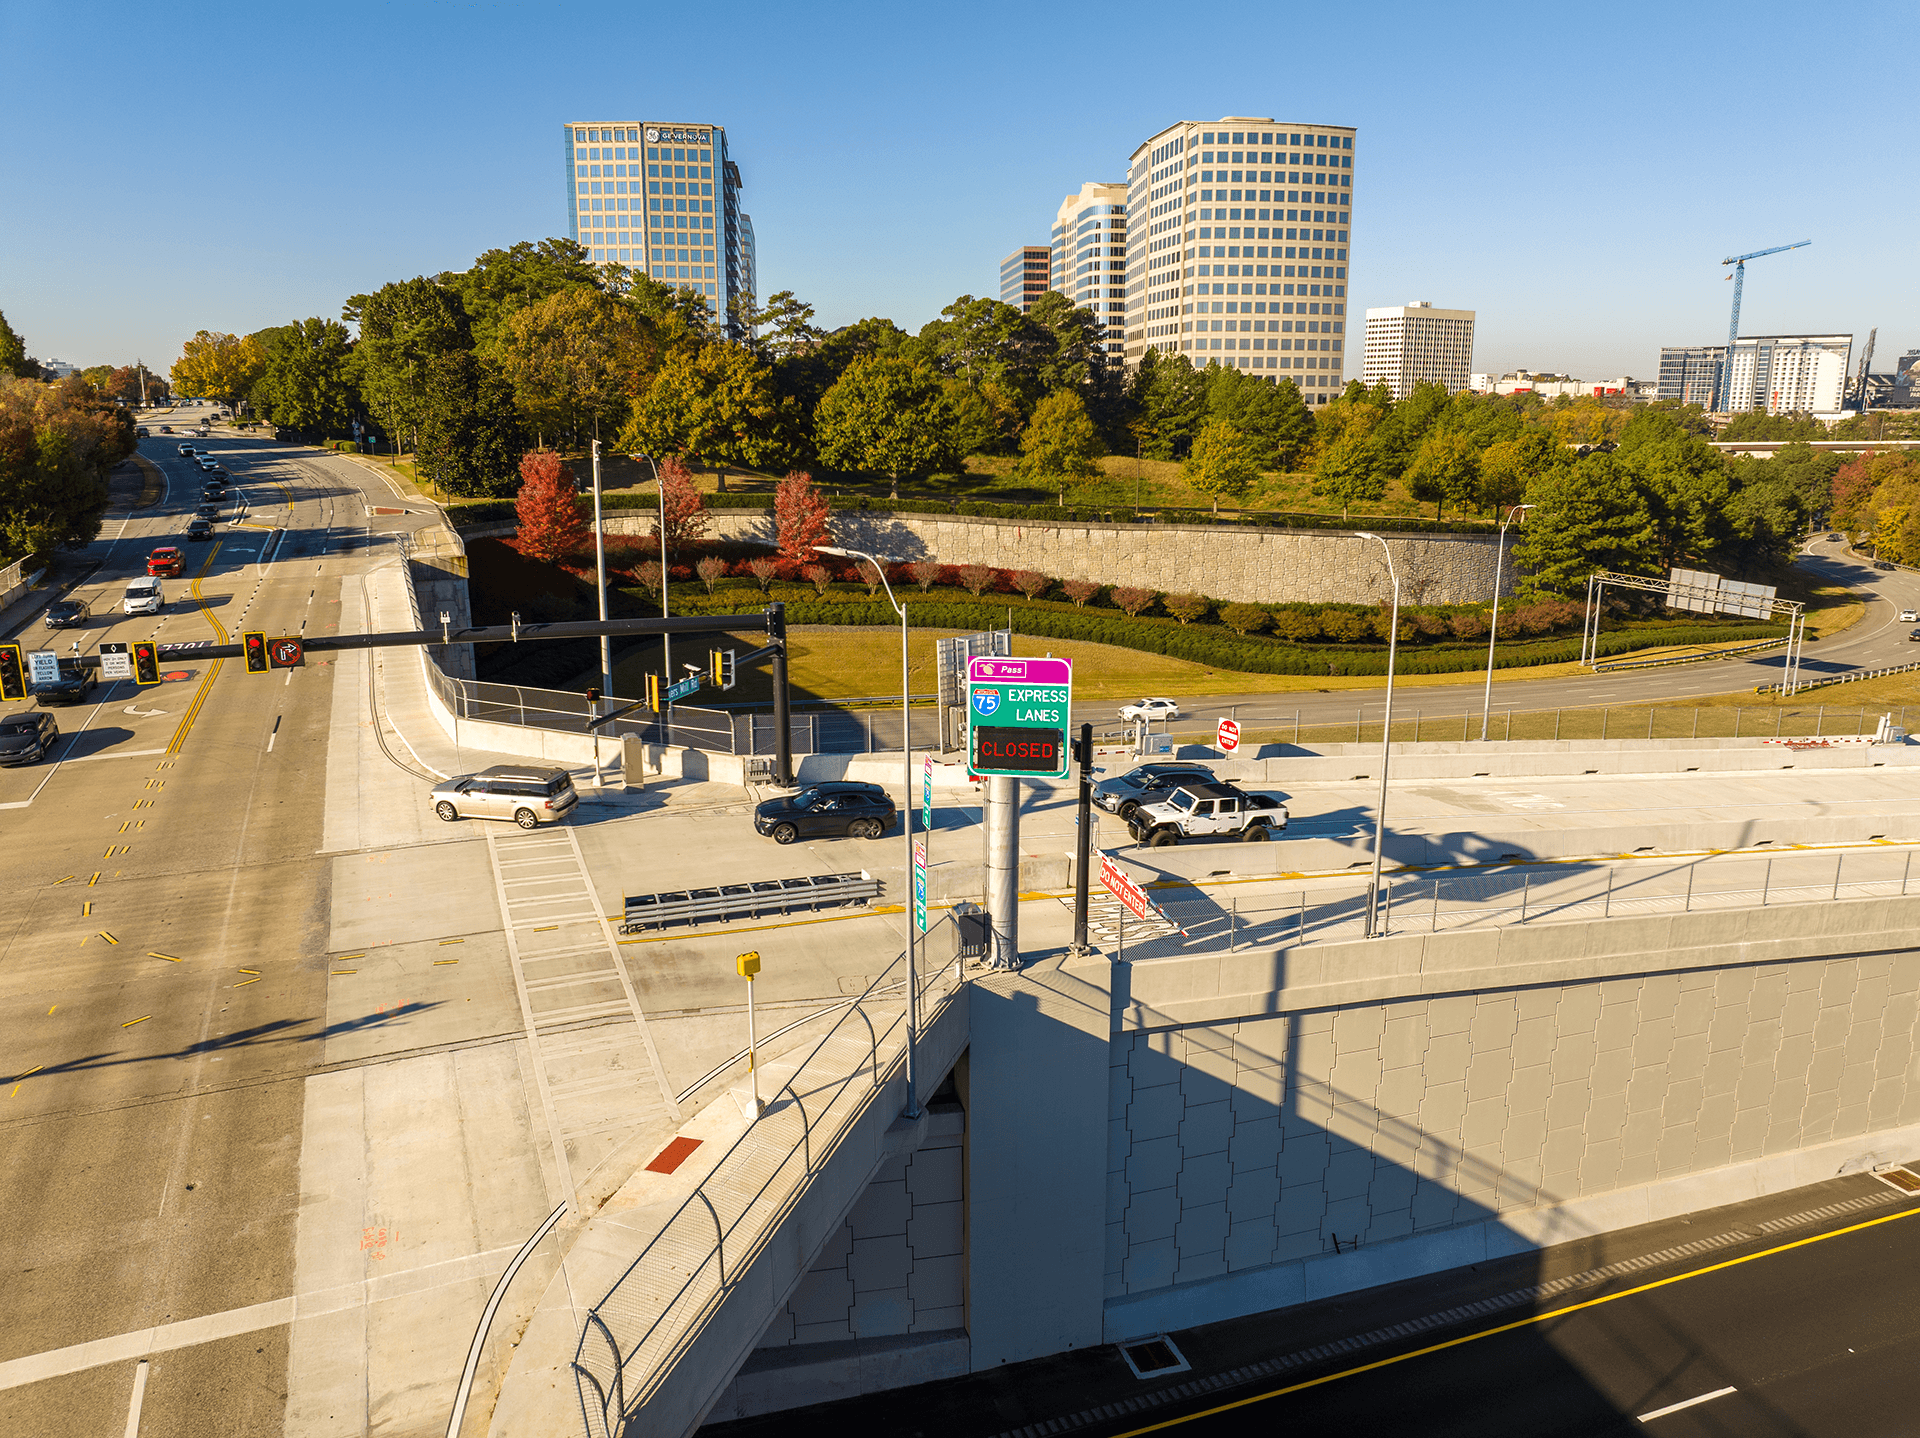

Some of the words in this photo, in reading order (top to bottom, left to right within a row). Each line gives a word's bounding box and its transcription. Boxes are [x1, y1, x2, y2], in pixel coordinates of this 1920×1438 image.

[1000, 666, 1022, 674] Pass
[691, 678, 698, 689] Rd
[1008, 689, 1067, 703] EXPRESS
[976, 696, 996, 710] 75
[1016, 709, 1059, 722] LANES
[1222, 738, 1234, 746] ENTER
[982, 741, 1053, 758] CLOSED
[1100, 867, 1110, 882] DO
[1110, 875, 1124, 895] NOT
[1123, 888, 1144, 915] ENTER
